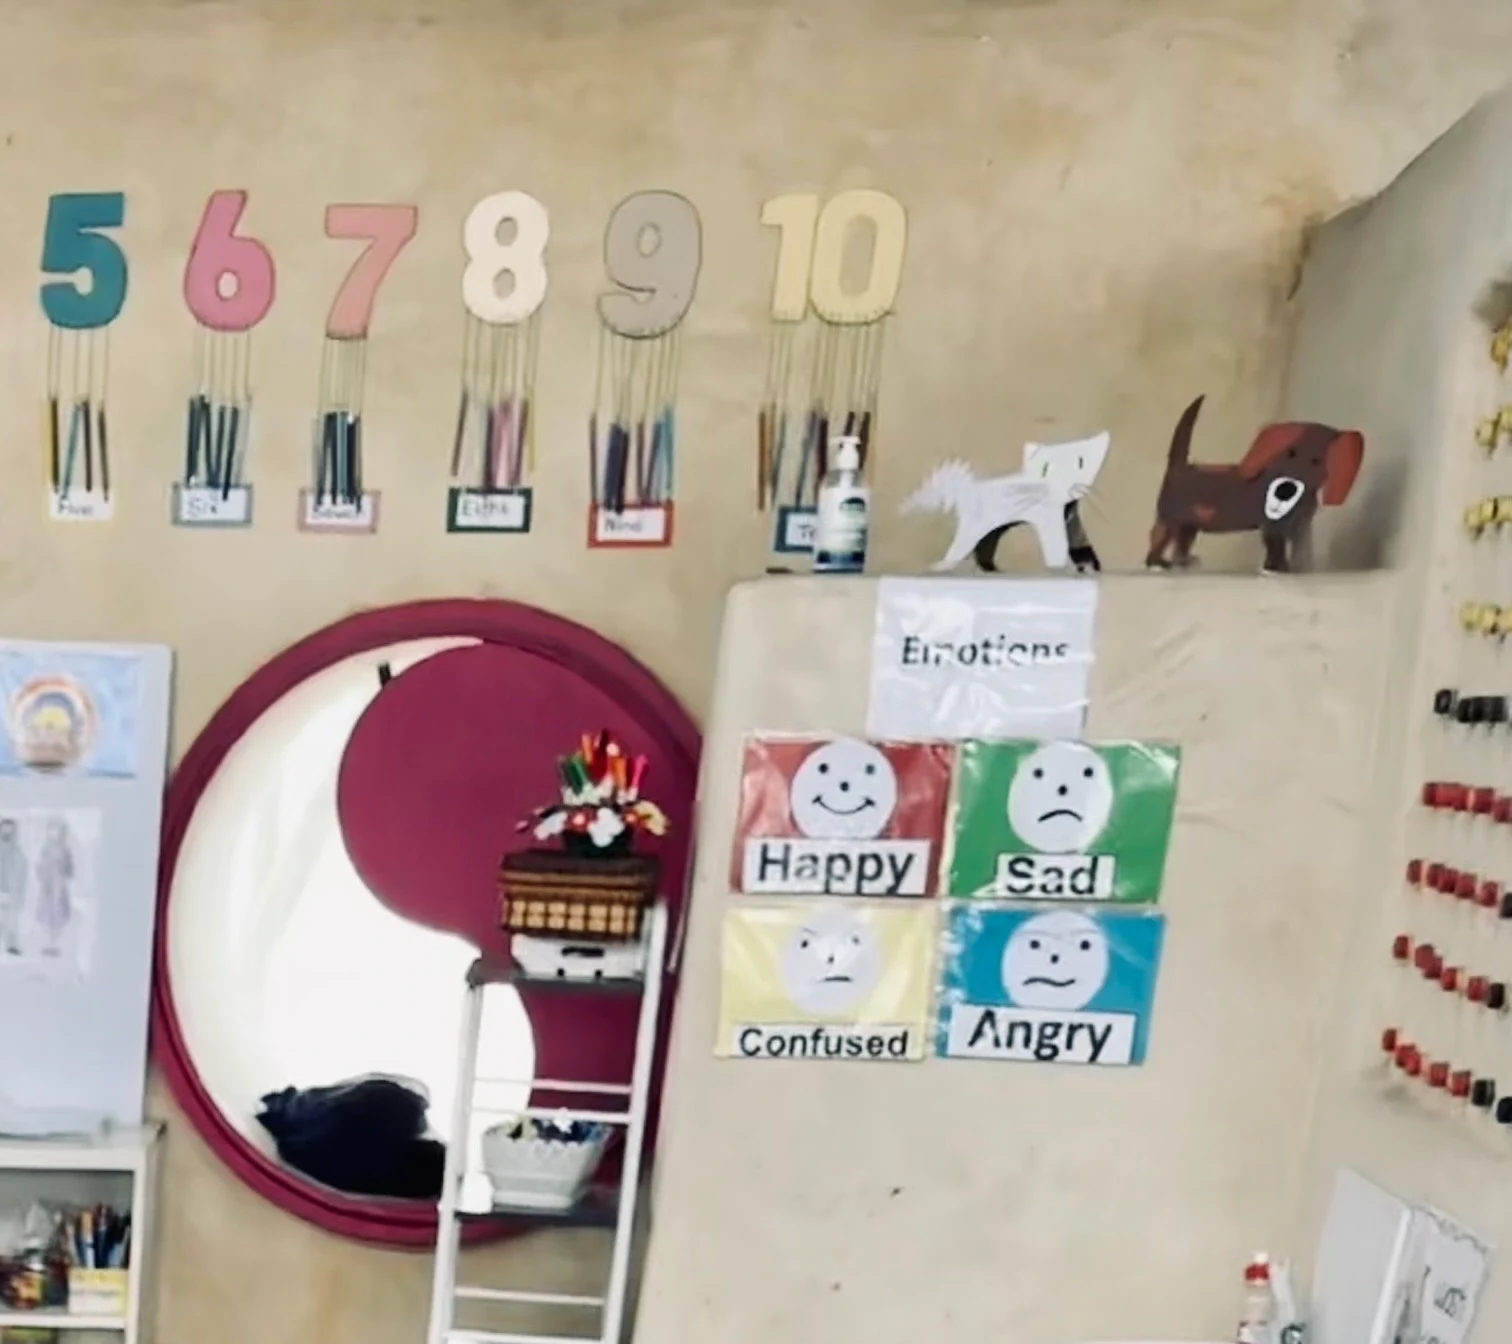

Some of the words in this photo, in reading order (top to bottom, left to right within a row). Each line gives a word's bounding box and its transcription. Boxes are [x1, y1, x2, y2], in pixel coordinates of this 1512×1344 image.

[40, 192, 129, 331] 5
[184, 190, 275, 332] 6
[324, 204, 418, 340] 7
[462, 190, 550, 326] 8
[596, 190, 703, 339] 9
[761, 190, 908, 325] 10
[900, 634, 1071, 668] Emotions
[758, 842, 915, 895] Happy
[1005, 856, 1098, 897] Sad
[738, 1027, 909, 1059] Confused
[968, 1009, 1114, 1063] Angry
